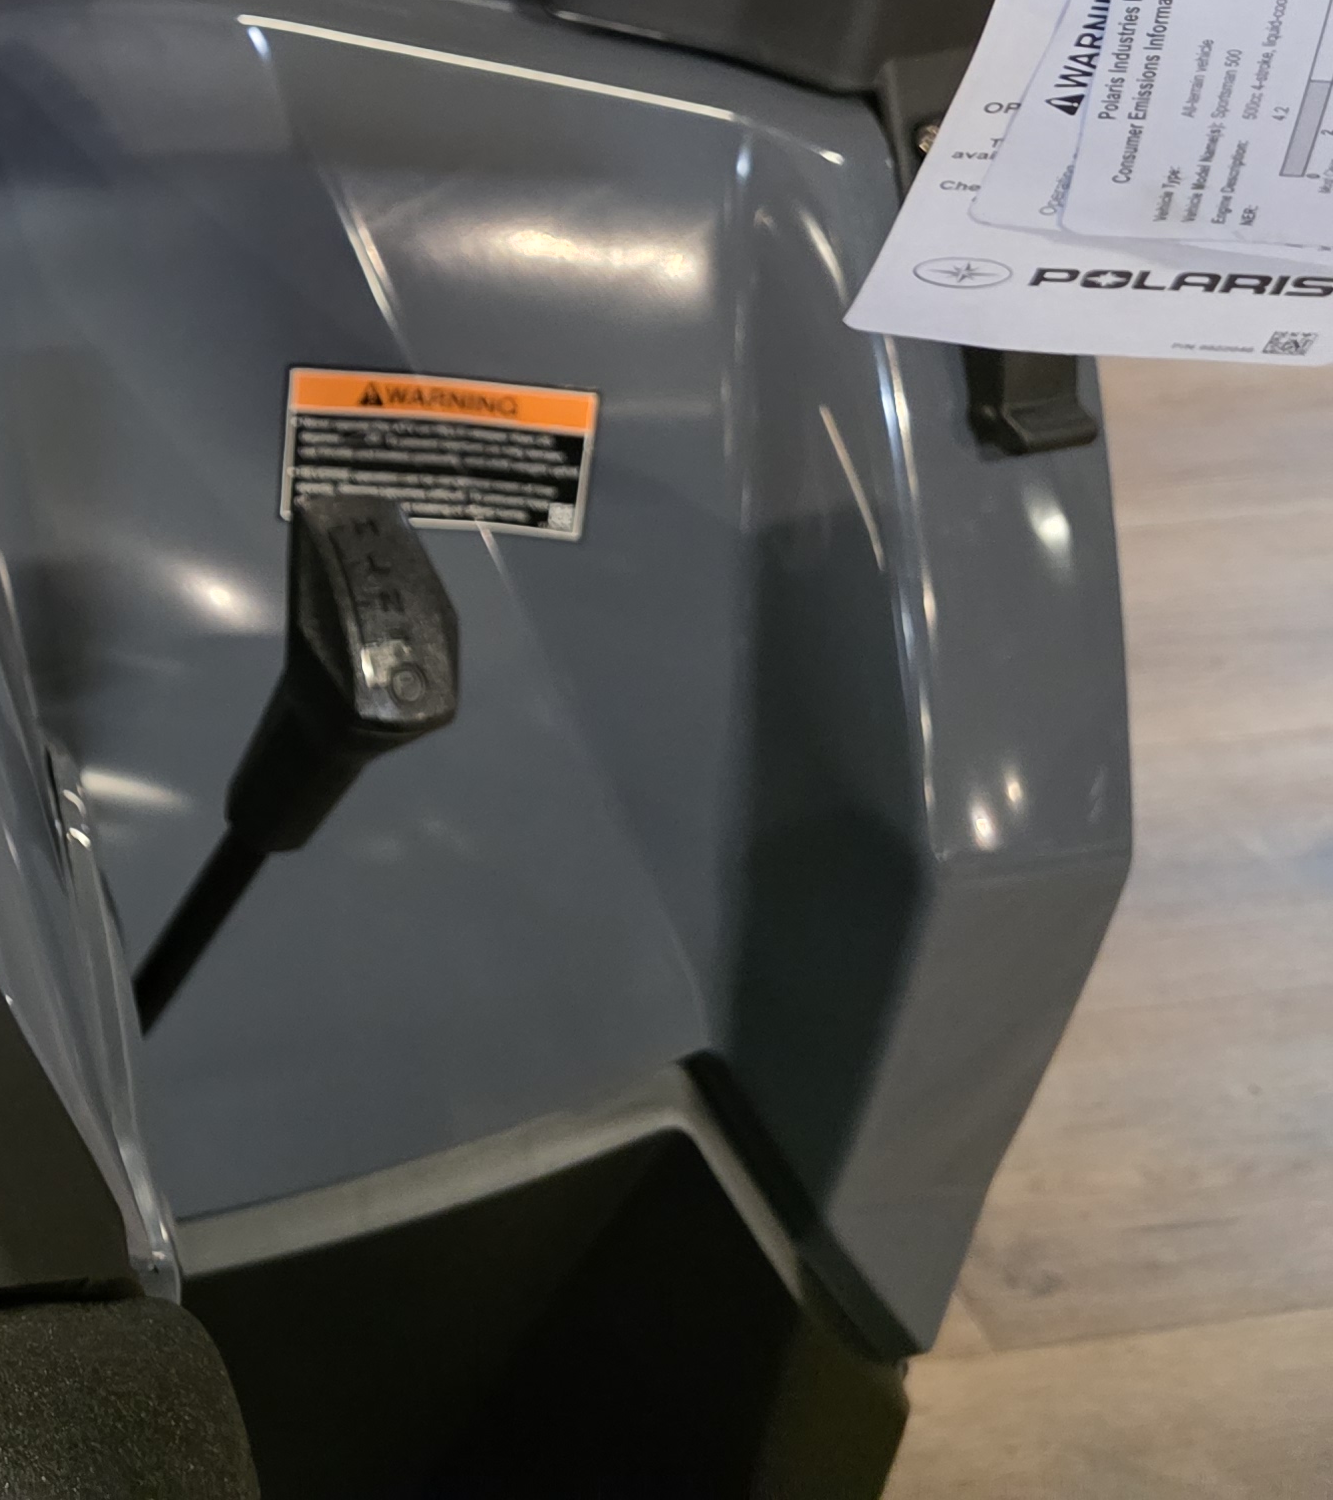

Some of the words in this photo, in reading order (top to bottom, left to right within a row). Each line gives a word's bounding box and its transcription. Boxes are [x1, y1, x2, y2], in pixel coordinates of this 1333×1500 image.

[1108, 5, 1139, 74] Industries
[1098, 76, 1125, 120] Polaris
[1127, 53, 1160, 121] Emissions
[1112, 121, 1144, 185] Consumer
[1028, 268, 1333, 297] POLARIS
[384, 385, 518, 416] WARNING
